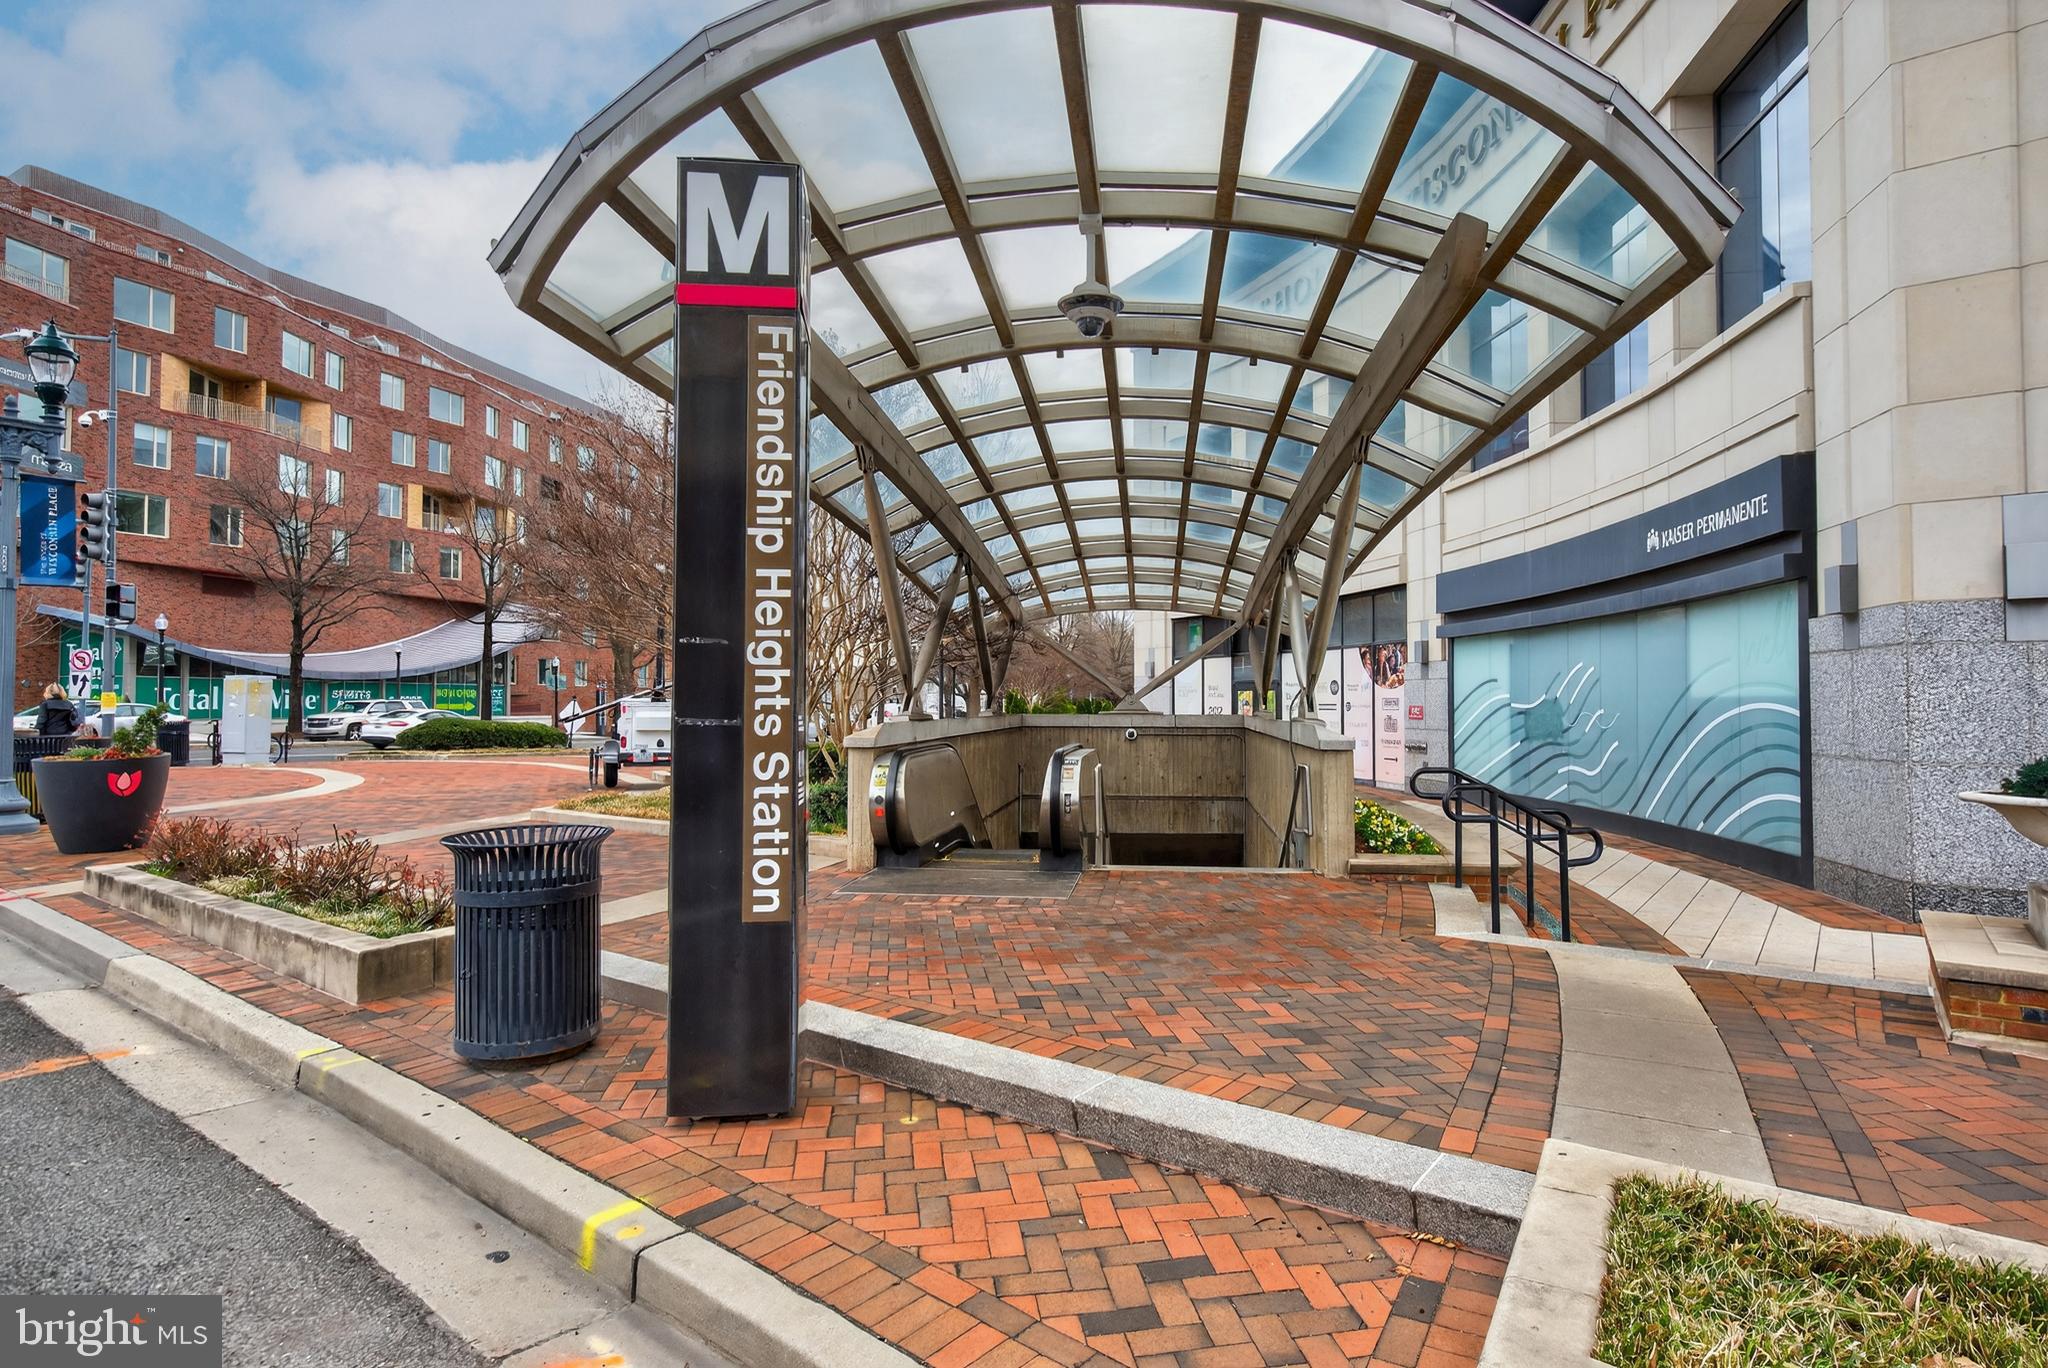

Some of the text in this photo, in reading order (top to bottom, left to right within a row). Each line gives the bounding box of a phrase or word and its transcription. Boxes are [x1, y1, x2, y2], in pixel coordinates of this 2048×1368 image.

[686, 171, 789, 276] M
[1661, 493, 1768, 548] KAISER PERMANENTE
[746, 325, 793, 914] Friendship Heights Station
